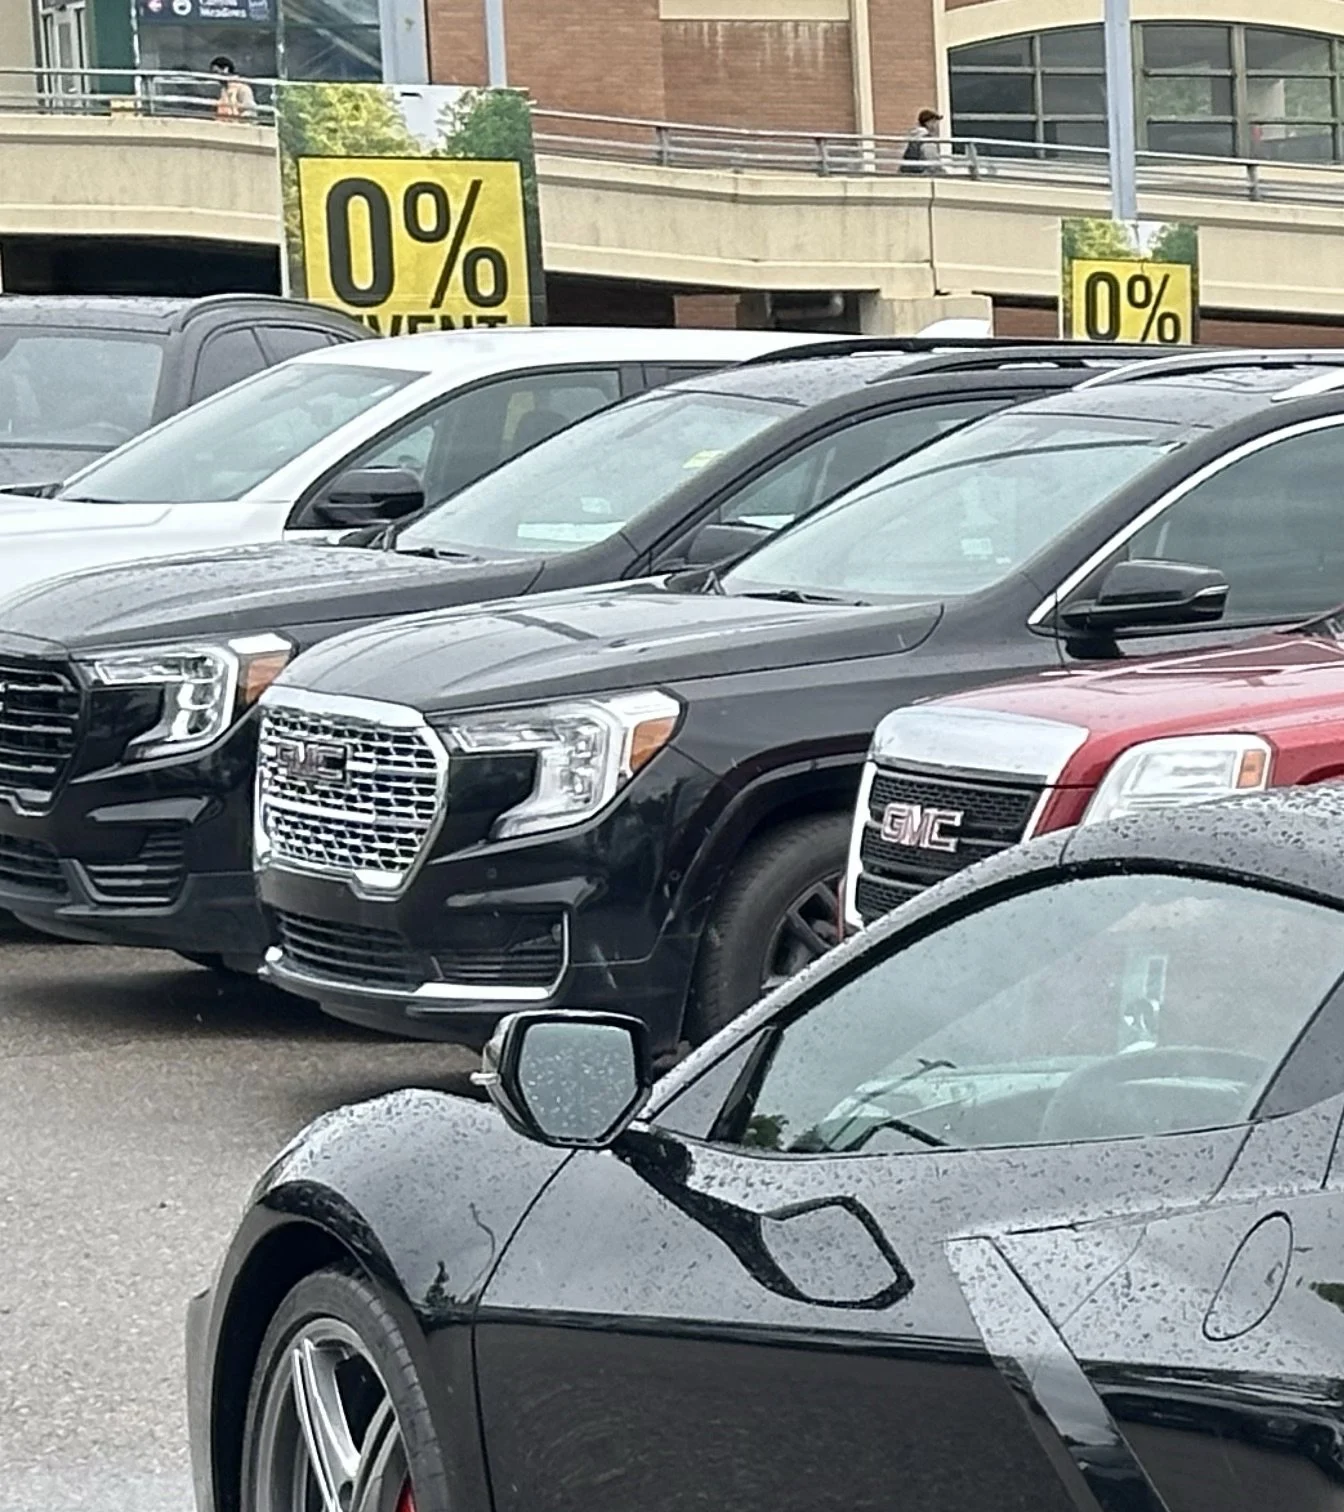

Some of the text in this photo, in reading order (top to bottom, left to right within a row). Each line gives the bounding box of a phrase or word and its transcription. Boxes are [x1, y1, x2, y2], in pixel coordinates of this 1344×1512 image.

[326, 177, 509, 308] 0%
[1085, 271, 1180, 344] 0%
[277, 741, 345, 780] GMC
[881, 802, 964, 852] GMC
